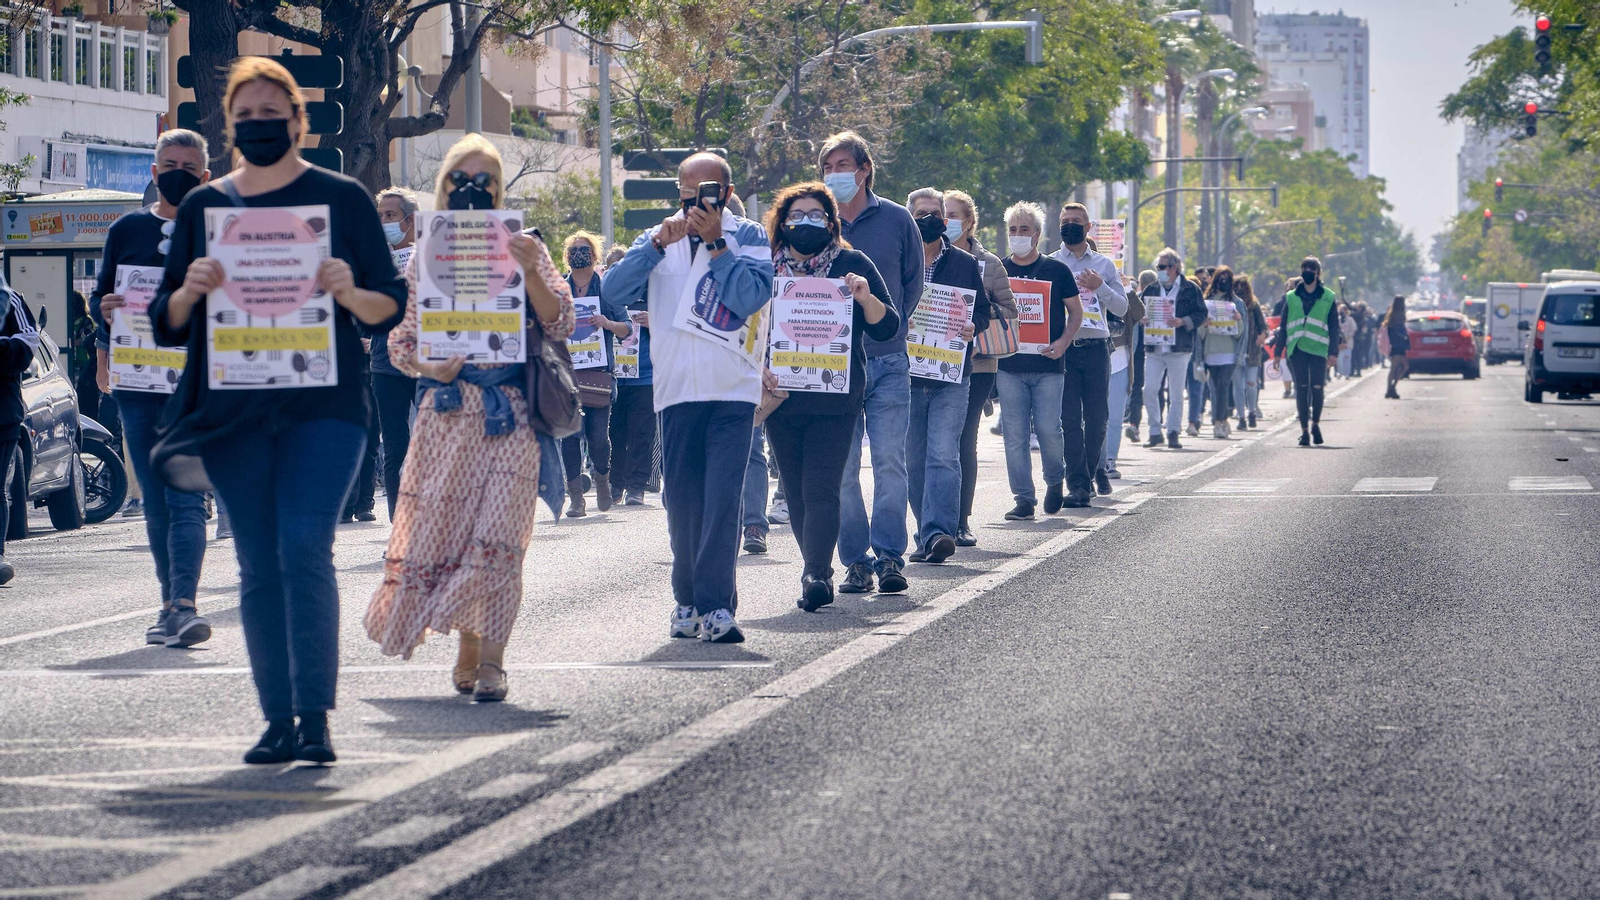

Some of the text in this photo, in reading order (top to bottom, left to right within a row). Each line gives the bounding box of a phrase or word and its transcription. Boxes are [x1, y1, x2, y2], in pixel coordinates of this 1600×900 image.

[460, 220, 494, 228] BÉLGICA
[254, 231, 296, 240] AUSTRIA
[698, 276, 713, 304] EN CÁDIZ
[426, 314, 516, 326] EN ESPAÑA NO
[218, 331, 322, 344] EN ESPAÑA NO
[134, 352, 172, 362] ESPAÑA
[917, 348, 945, 358] ESPAÑA
[792, 356, 827, 364] ESPAÑA
